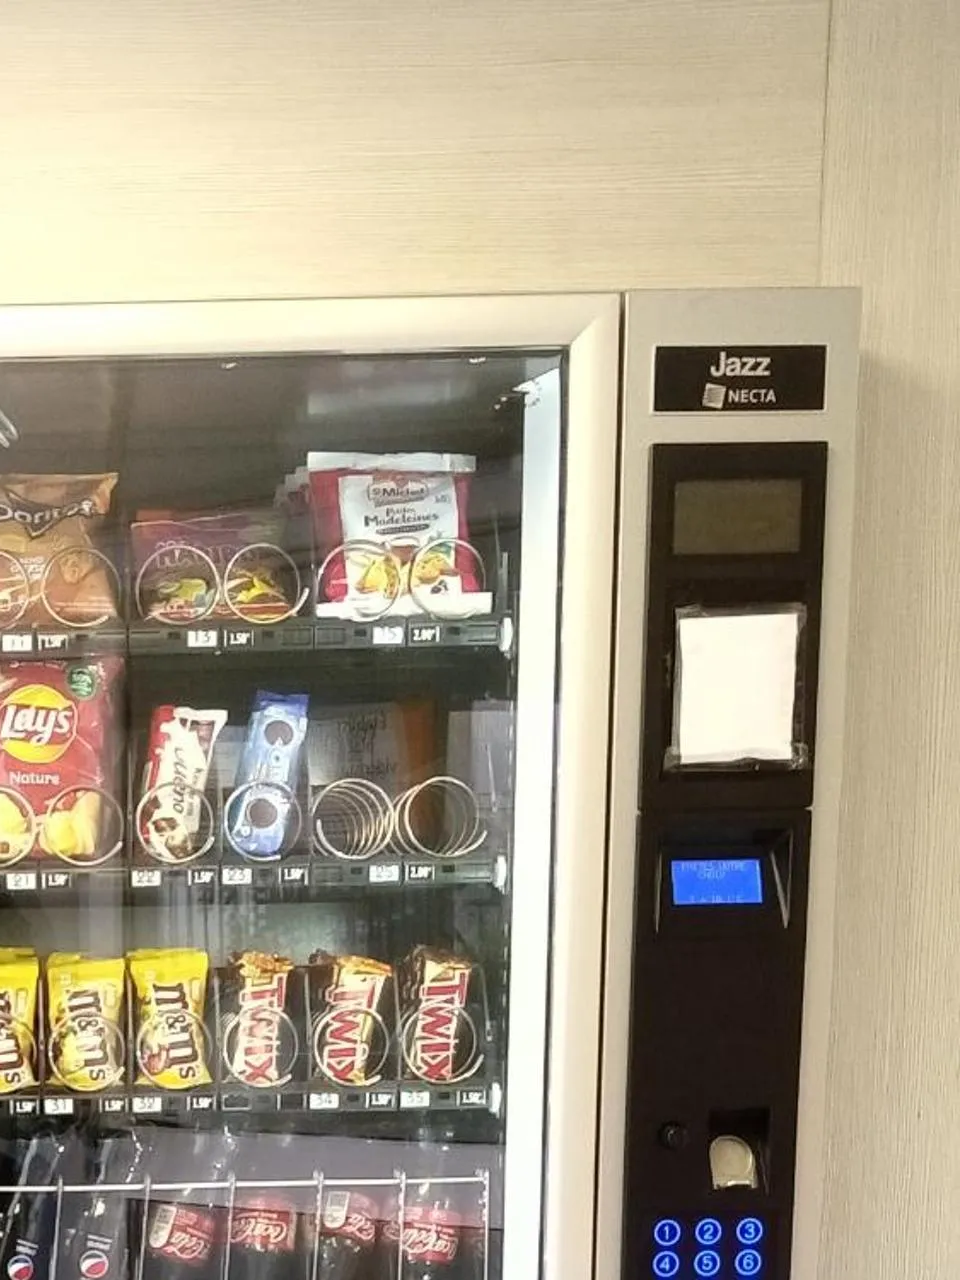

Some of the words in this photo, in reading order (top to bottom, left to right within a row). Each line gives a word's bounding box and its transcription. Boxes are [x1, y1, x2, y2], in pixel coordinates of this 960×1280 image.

[710, 351, 771, 377] Jazz
[728, 389, 776, 403] NECTA
[8, 771, 60, 786] Nature
[663, 1226, 670, 1240] 1
[703, 1224, 714, 1240] 2
[744, 1223, 756, 1238] 3
[659, 1257, 670, 1271] 4
[702, 1256, 713, 1270] 5
[743, 1255, 754, 1270] 6
